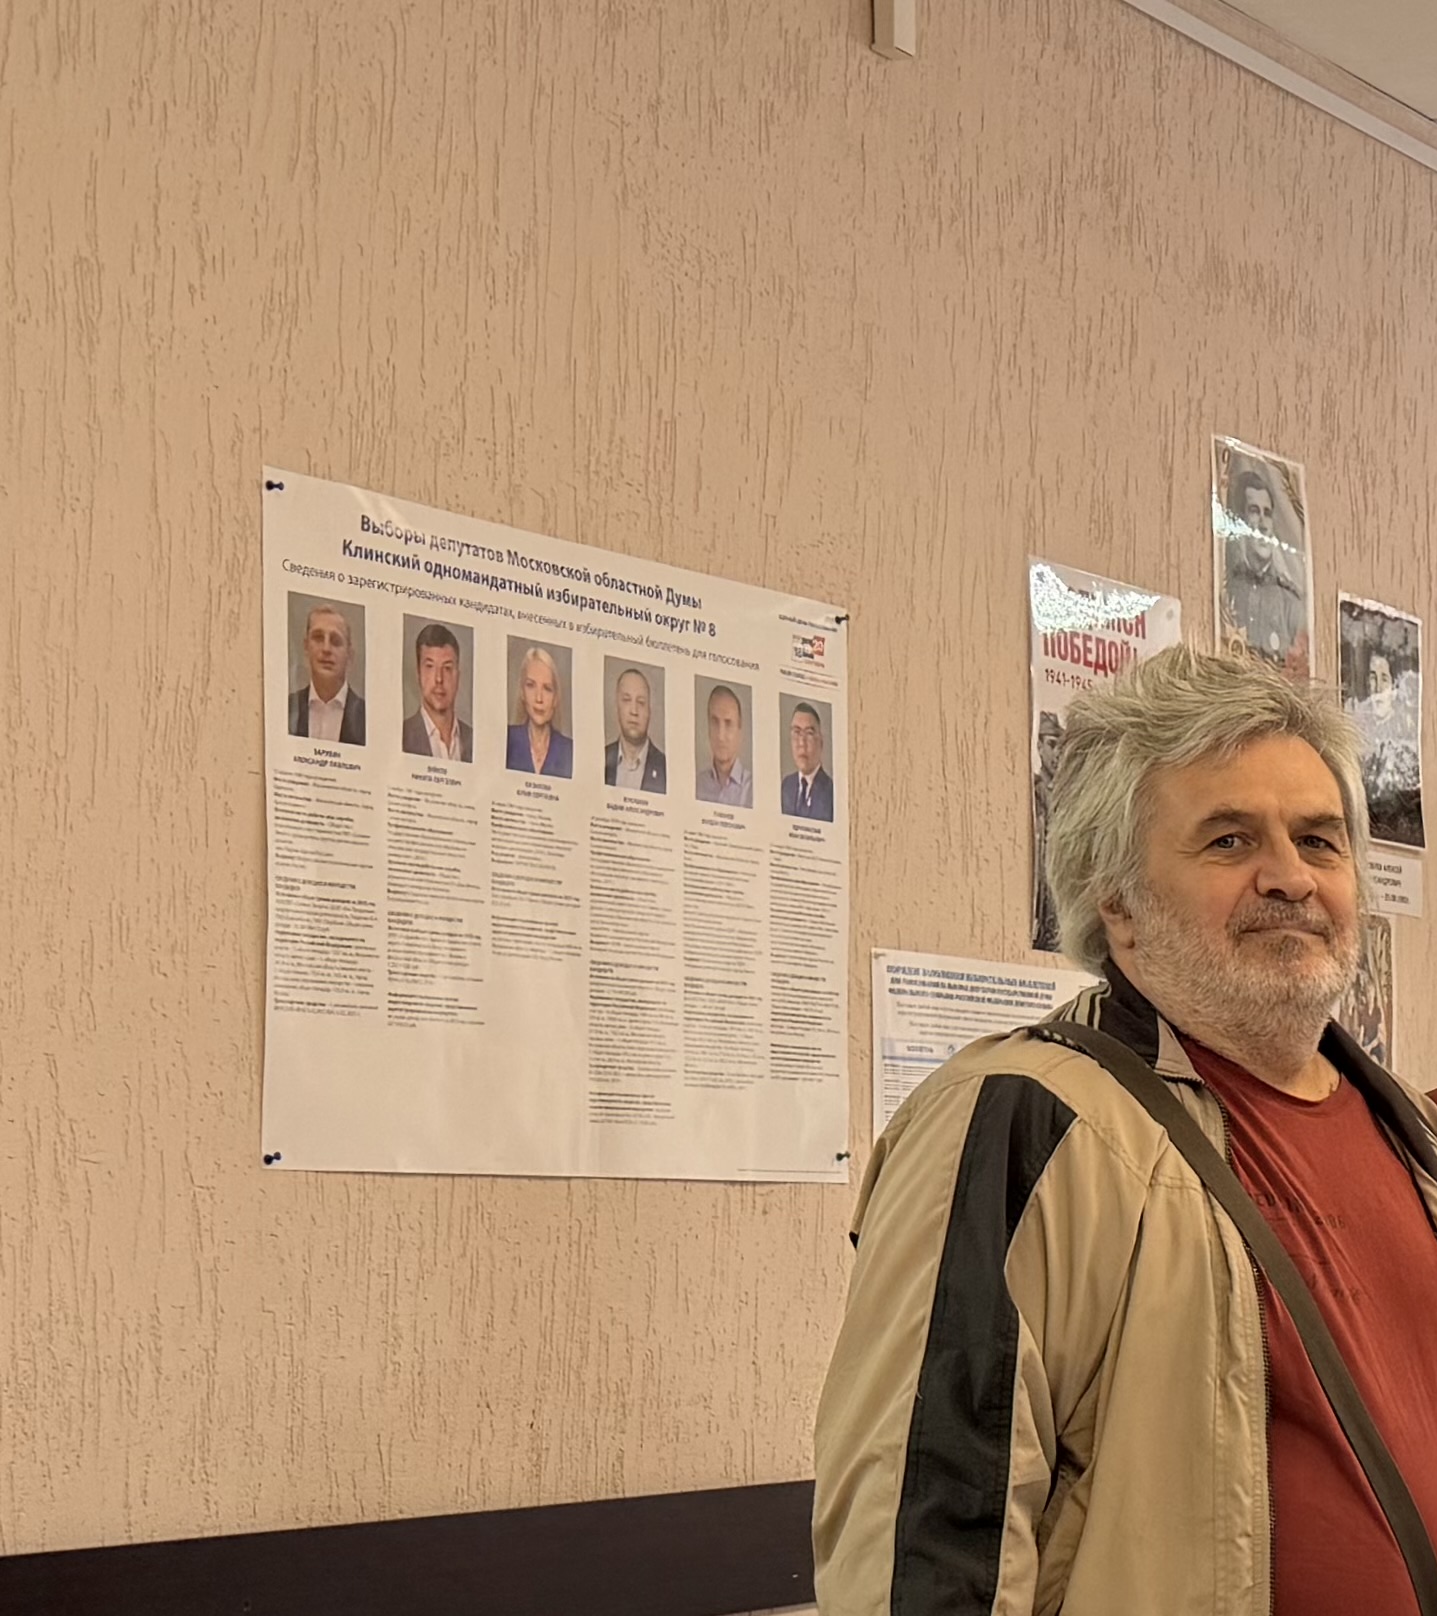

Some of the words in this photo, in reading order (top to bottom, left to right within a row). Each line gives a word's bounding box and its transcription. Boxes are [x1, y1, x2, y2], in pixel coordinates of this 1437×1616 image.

[282, 558, 336, 582] Сведения
[338, 573, 345, 583] о
[342, 539, 421, 572] Клинский
[424, 560, 544, 599] одномандатный
[546, 588, 652, 623] избирательный
[655, 611, 690, 634] округ
[693, 619, 706, 634] №
[708, 621, 717, 638] 8
[361, 514, 426, 546] Выборы
[430, 535, 504, 564] депутатов
[507, 549, 591, 584] Московской
[594, 571, 663, 601] областной
[665, 587, 702, 610] Думы
